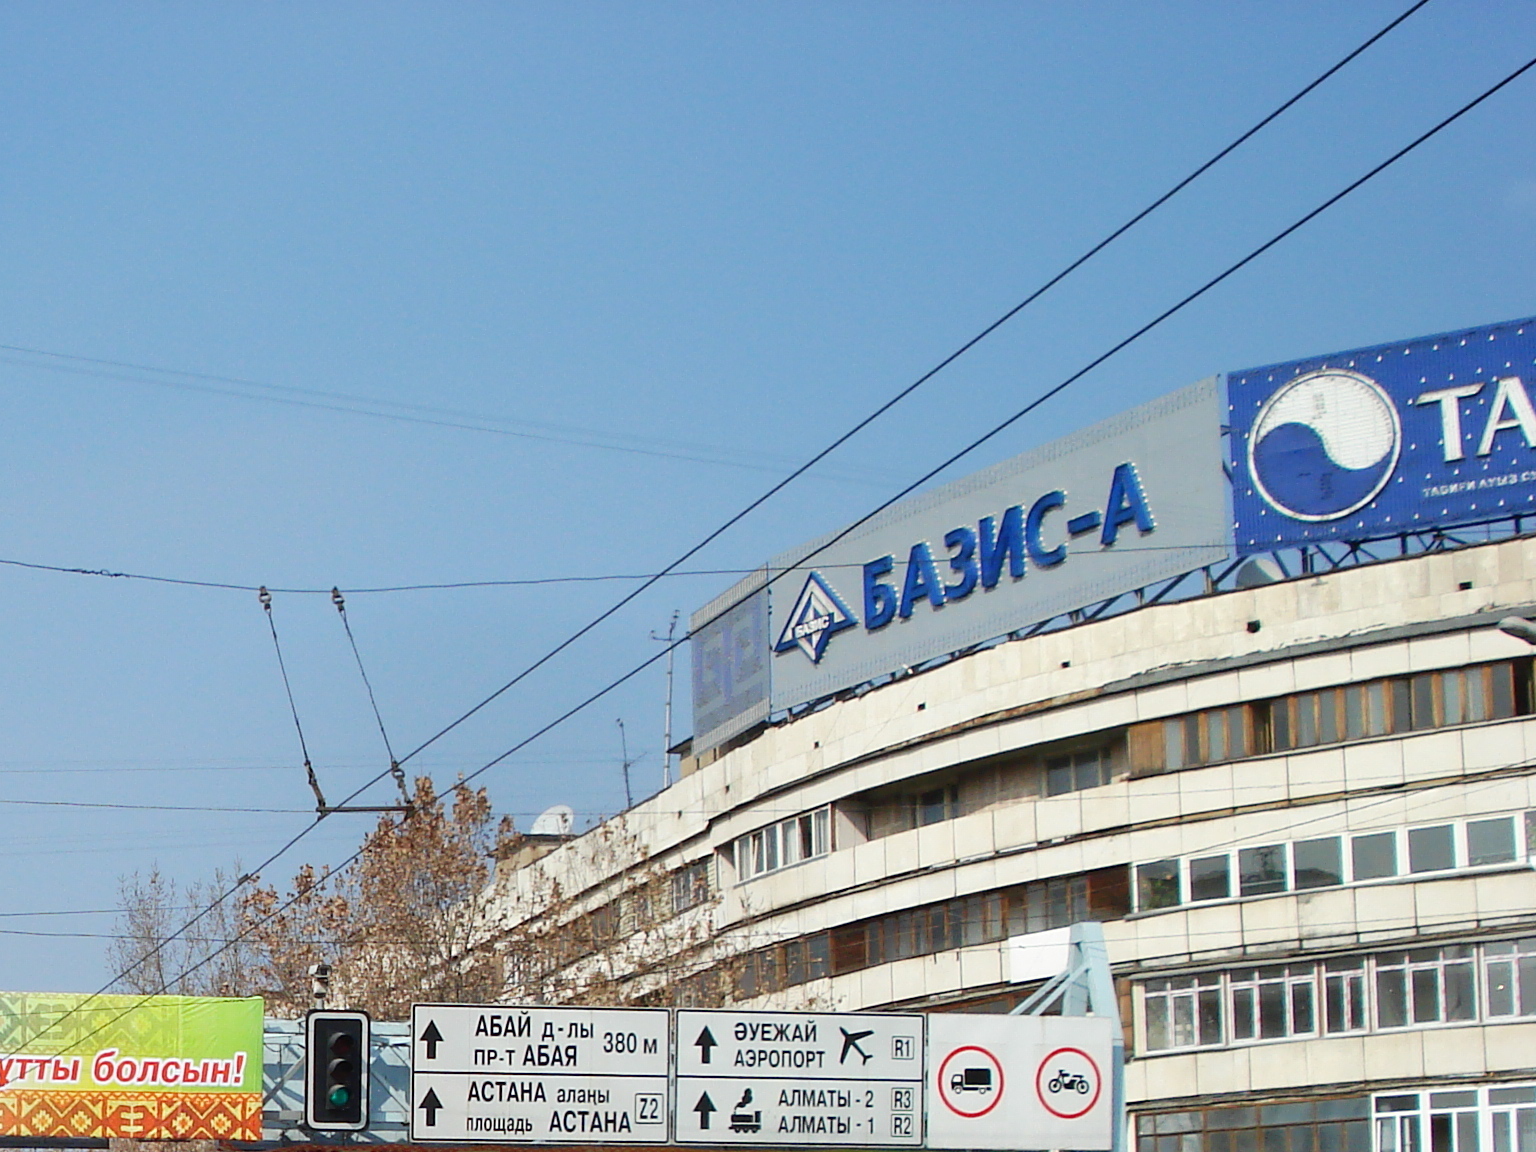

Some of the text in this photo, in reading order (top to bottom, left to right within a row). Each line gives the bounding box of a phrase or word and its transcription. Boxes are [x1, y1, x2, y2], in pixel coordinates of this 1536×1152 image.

[863, 461, 1157, 632] БАЗИС-А
[475, 1011, 531, 1037] АБАЙ
[603, 1032, 637, 1053] 380
[734, 1020, 911, 1057] ӘУЕЖАЙ R1
[94, 1050, 245, 1084] болсын!
[522, 1045, 577, 1066] АБАЯ
[734, 1049, 825, 1068] АЭРОПОРТ
[468, 1081, 659, 1119] АСТАНА алаңы Z2
[778, 1089, 851, 1108] АЛМАТЫ
[865, 1090, 874, 1108] 2
[894, 1090, 911, 1108] R3
[466, 1111, 632, 1135] площадь АСТАНА
[778, 1115, 851, 1134] АЛМАТЫ
[868, 1117, 874, 1134] 1
[894, 1117, 911, 1134] R2
